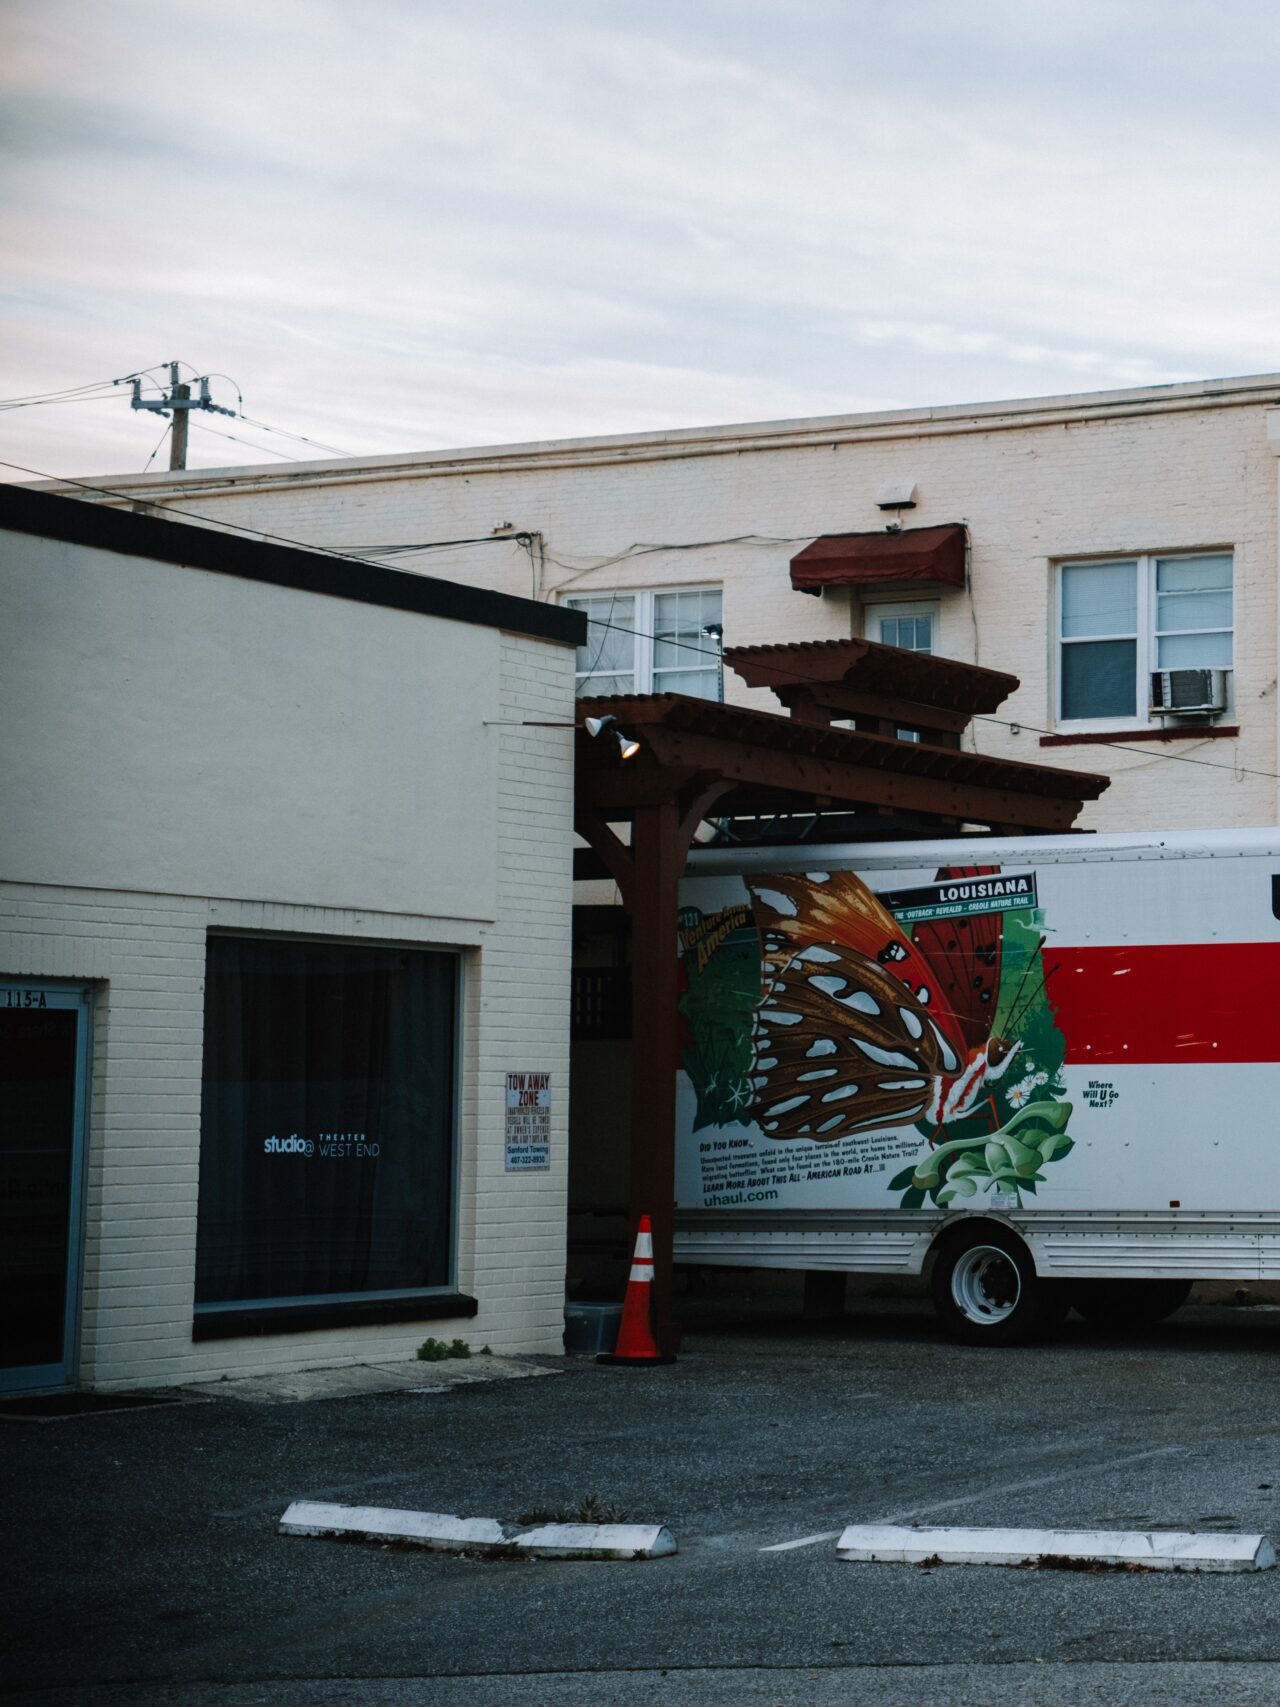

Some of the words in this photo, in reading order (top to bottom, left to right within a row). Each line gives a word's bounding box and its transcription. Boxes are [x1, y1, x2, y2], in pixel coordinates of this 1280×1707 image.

[939, 878, 1028, 902] LOUISIANA
[936, 904, 963, 915] REVEALED
[968, 901, 989, 911] CREOLE
[990, 898, 1012, 908] NATURE
[1013, 896, 1028, 905] TRAIL
[696, 912, 747, 977] America
[7, 991, 47, 1008] 115-A
[508, 1074, 525, 1091] TOW
[528, 1074, 549, 1091] AWAY
[1088, 1080, 1113, 1089] Where
[519, 1090, 539, 1107] ZONE
[1082, 1090, 1098, 1099] Will
[1100, 1090, 1107, 1101] U
[1108, 1090, 1119, 1099] Go
[319, 1133, 366, 1141] THEATER
[319, 1143, 352, 1157] WEST
[356, 1143, 380, 1157] END
[530, 1145, 549, 1155] Towing
[700, 1143, 711, 1152] DID
[713, 1141, 727, 1151] YOU
[785, 1146, 793, 1154] the
[842, 1138, 869, 1147] southwest
[760, 1166, 775, 1174] What
[881, 1152, 900, 1160] Nature
[902, 1148, 918, 1157] Trail?
[805, 1153, 821, 1161] places
[703, 1181, 724, 1193] LEARN
[725, 1178, 745, 1190] MORE
[747, 1176, 770, 1188] ABOUT
[772, 1174, 787, 1184] THIS
[807, 1168, 842, 1180] AMERICAN
[843, 1166, 862, 1177] ROAD
[704, 1189, 778, 1208] uhaul.com
